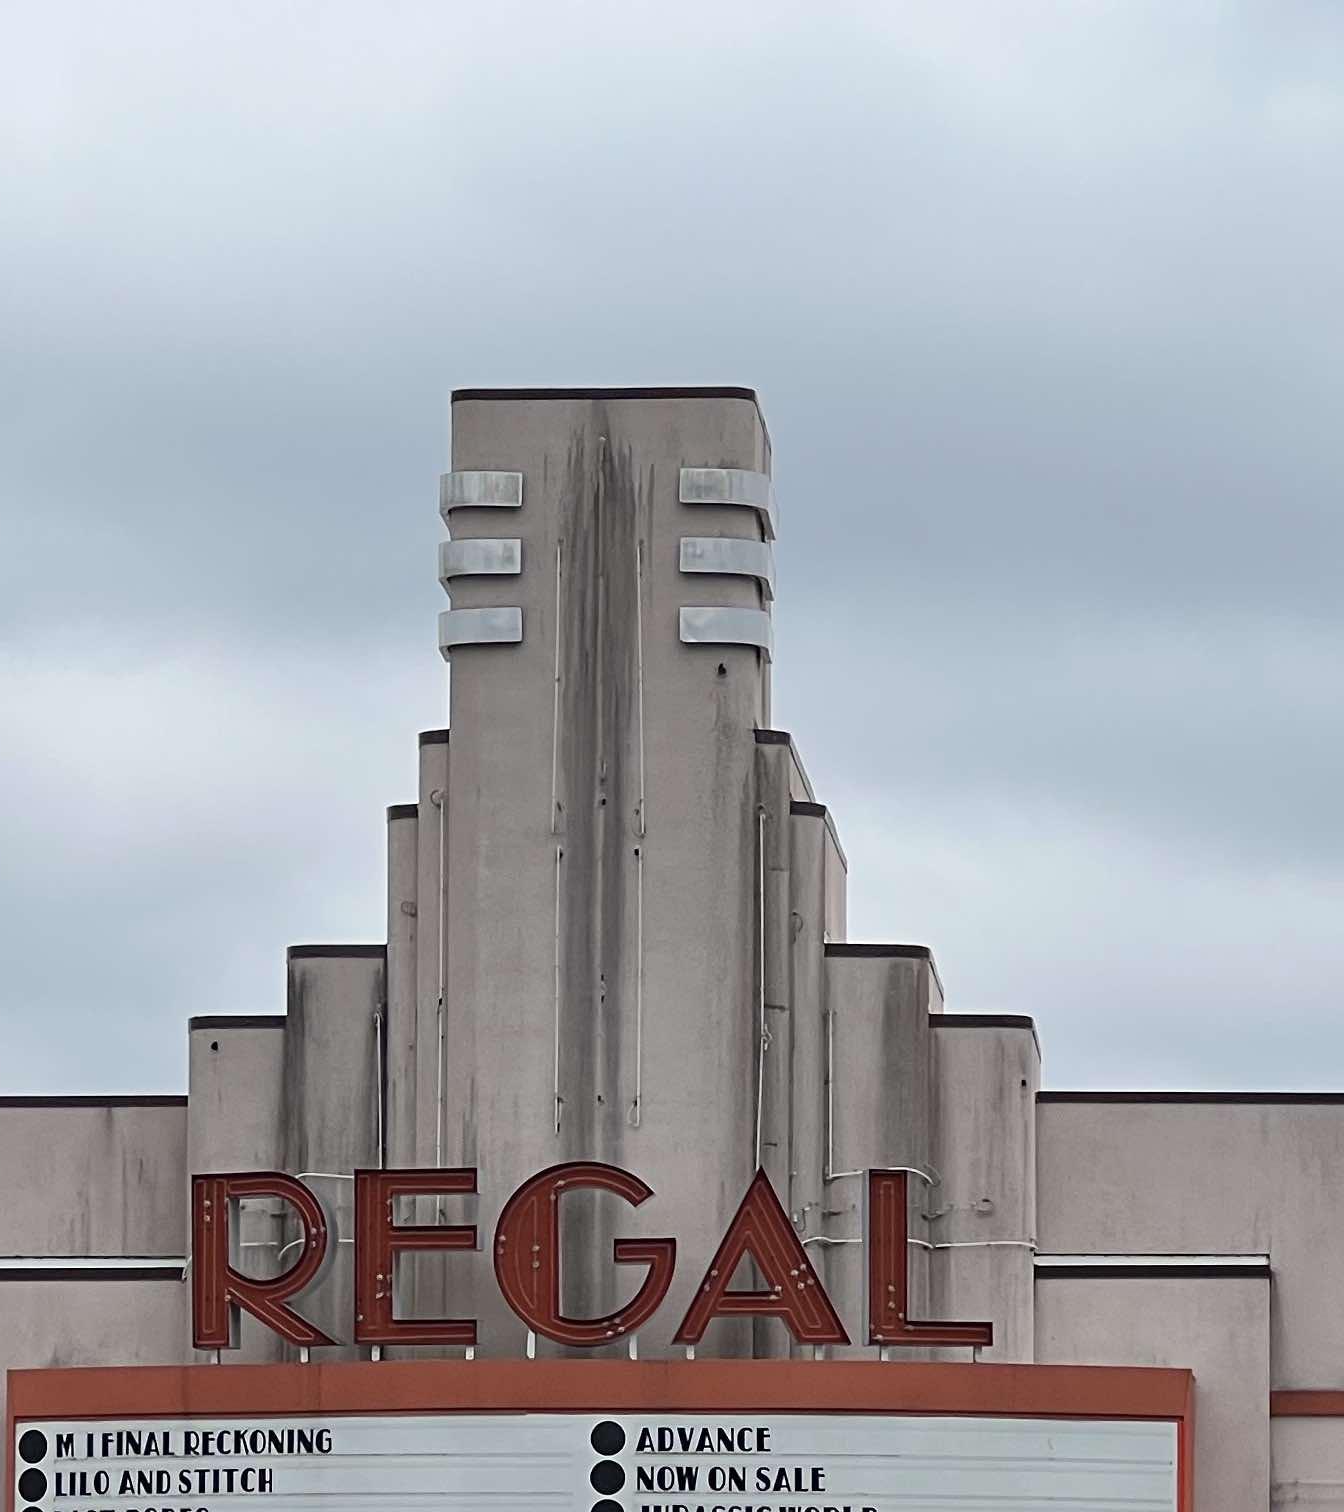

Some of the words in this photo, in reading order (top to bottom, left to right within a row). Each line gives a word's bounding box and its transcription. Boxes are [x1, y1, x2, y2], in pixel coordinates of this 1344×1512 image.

[191, 1161, 994, 1351] REGAL
[55, 1432, 76, 1458] M
[183, 1428, 333, 1457] RECKONING
[635, 1426, 772, 1453] ADVANCE
[55, 1470, 110, 1497] LILO
[118, 1469, 172, 1496] AND
[178, 1467, 274, 1495] STITCH
[636, 1466, 699, 1492] NOW
[708, 1466, 747, 1493] ON
[755, 1466, 827, 1493] SALE
